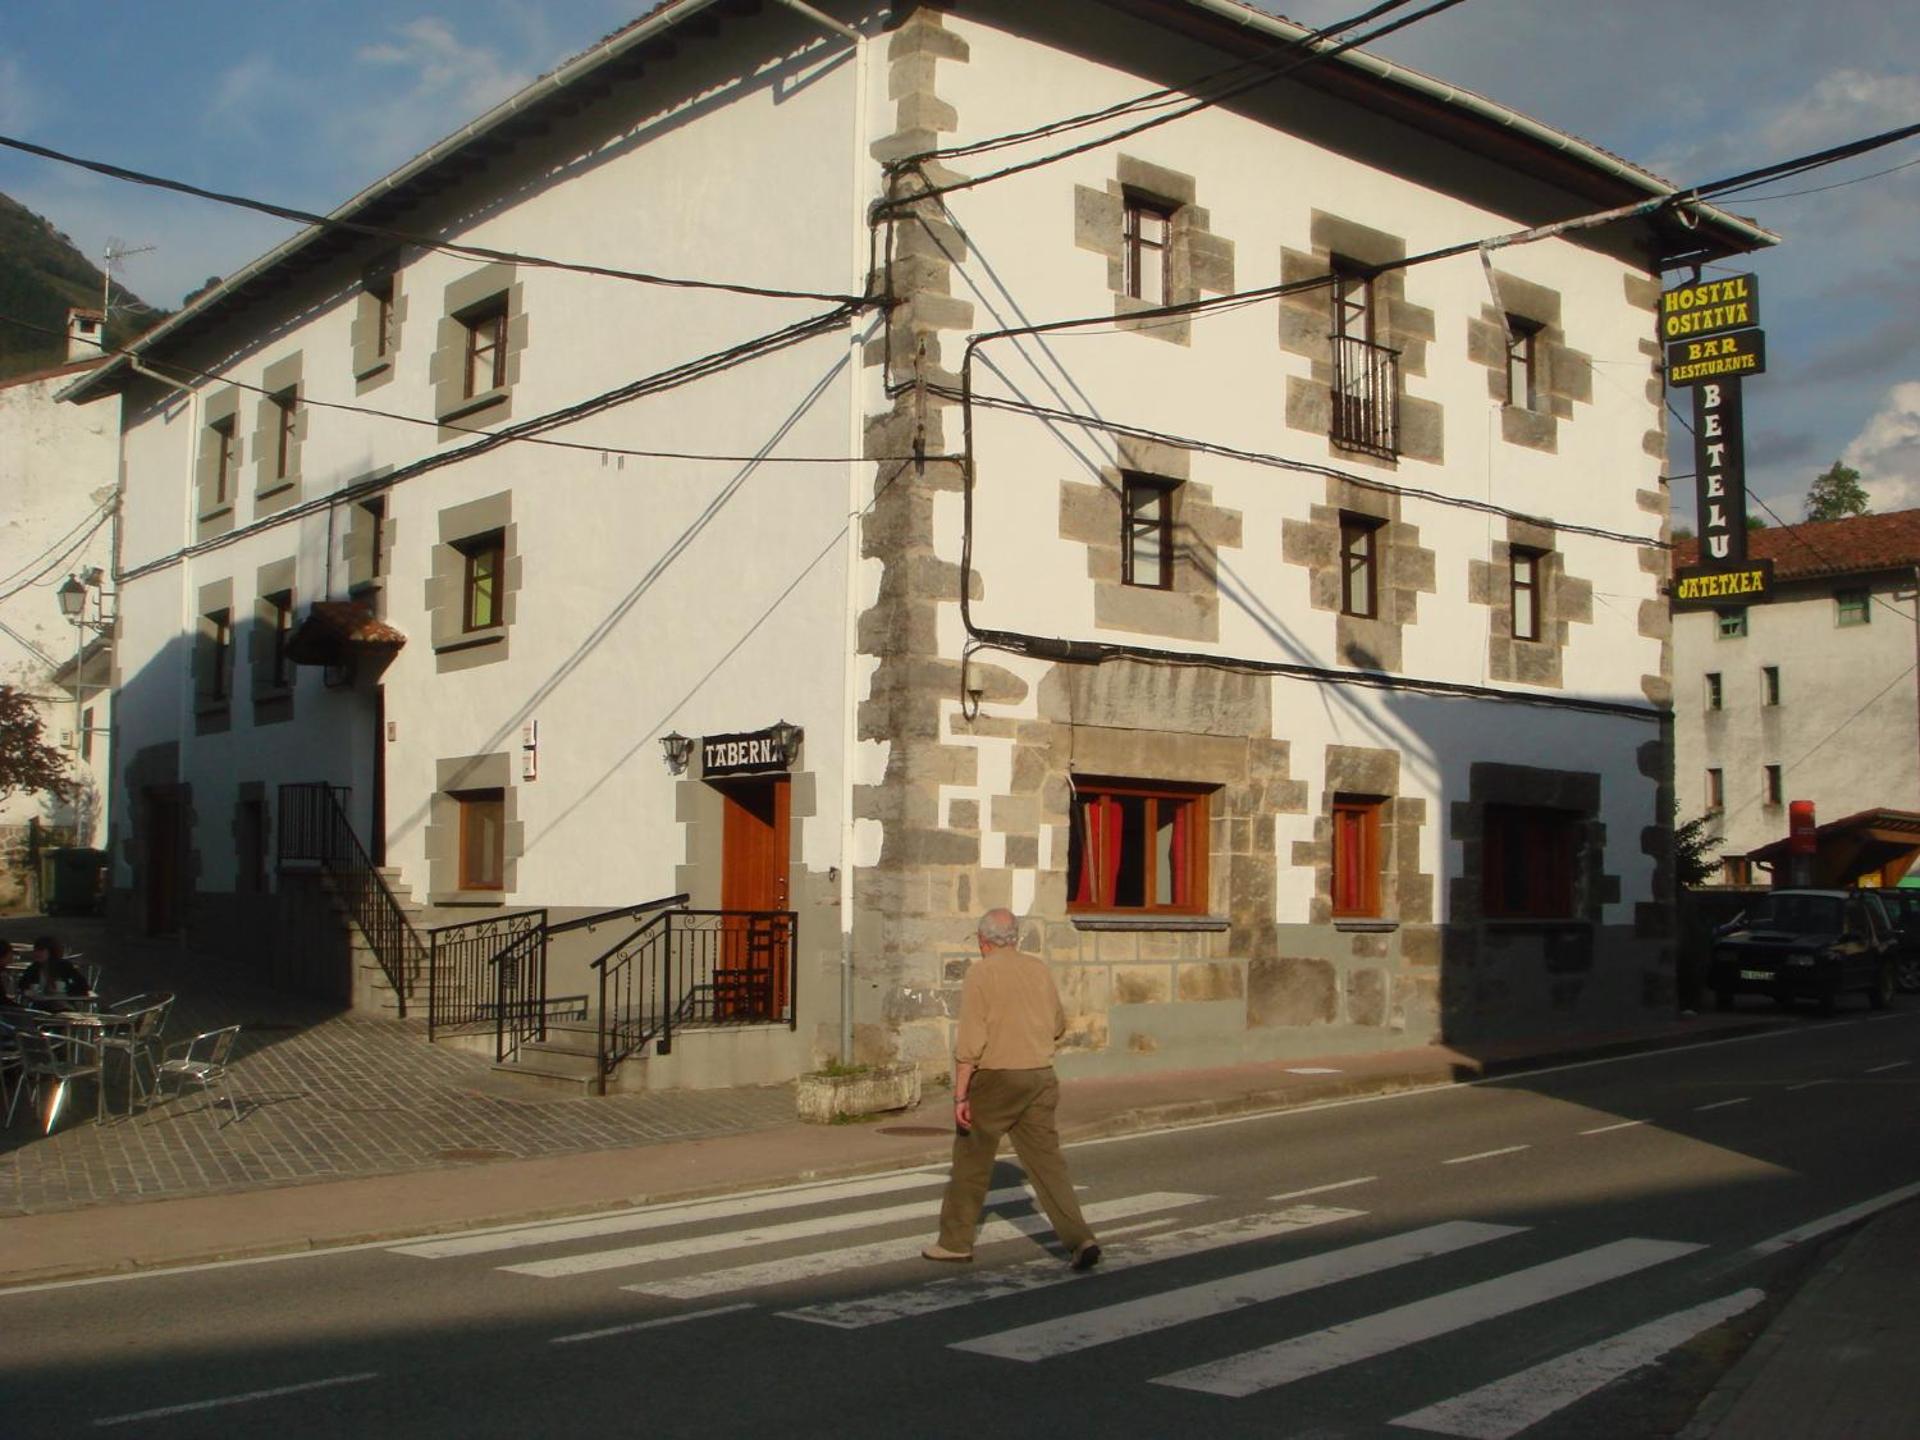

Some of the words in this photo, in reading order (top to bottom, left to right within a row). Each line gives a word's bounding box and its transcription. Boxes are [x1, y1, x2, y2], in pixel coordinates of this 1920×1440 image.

[1665, 278, 1748, 312] HOSTAL
[1688, 337, 1738, 360] BAR
[1672, 354, 1756, 381] RESTAURANTE
[1703, 384, 1729, 558] BETELU
[1678, 570, 1763, 599] JATETXEA
